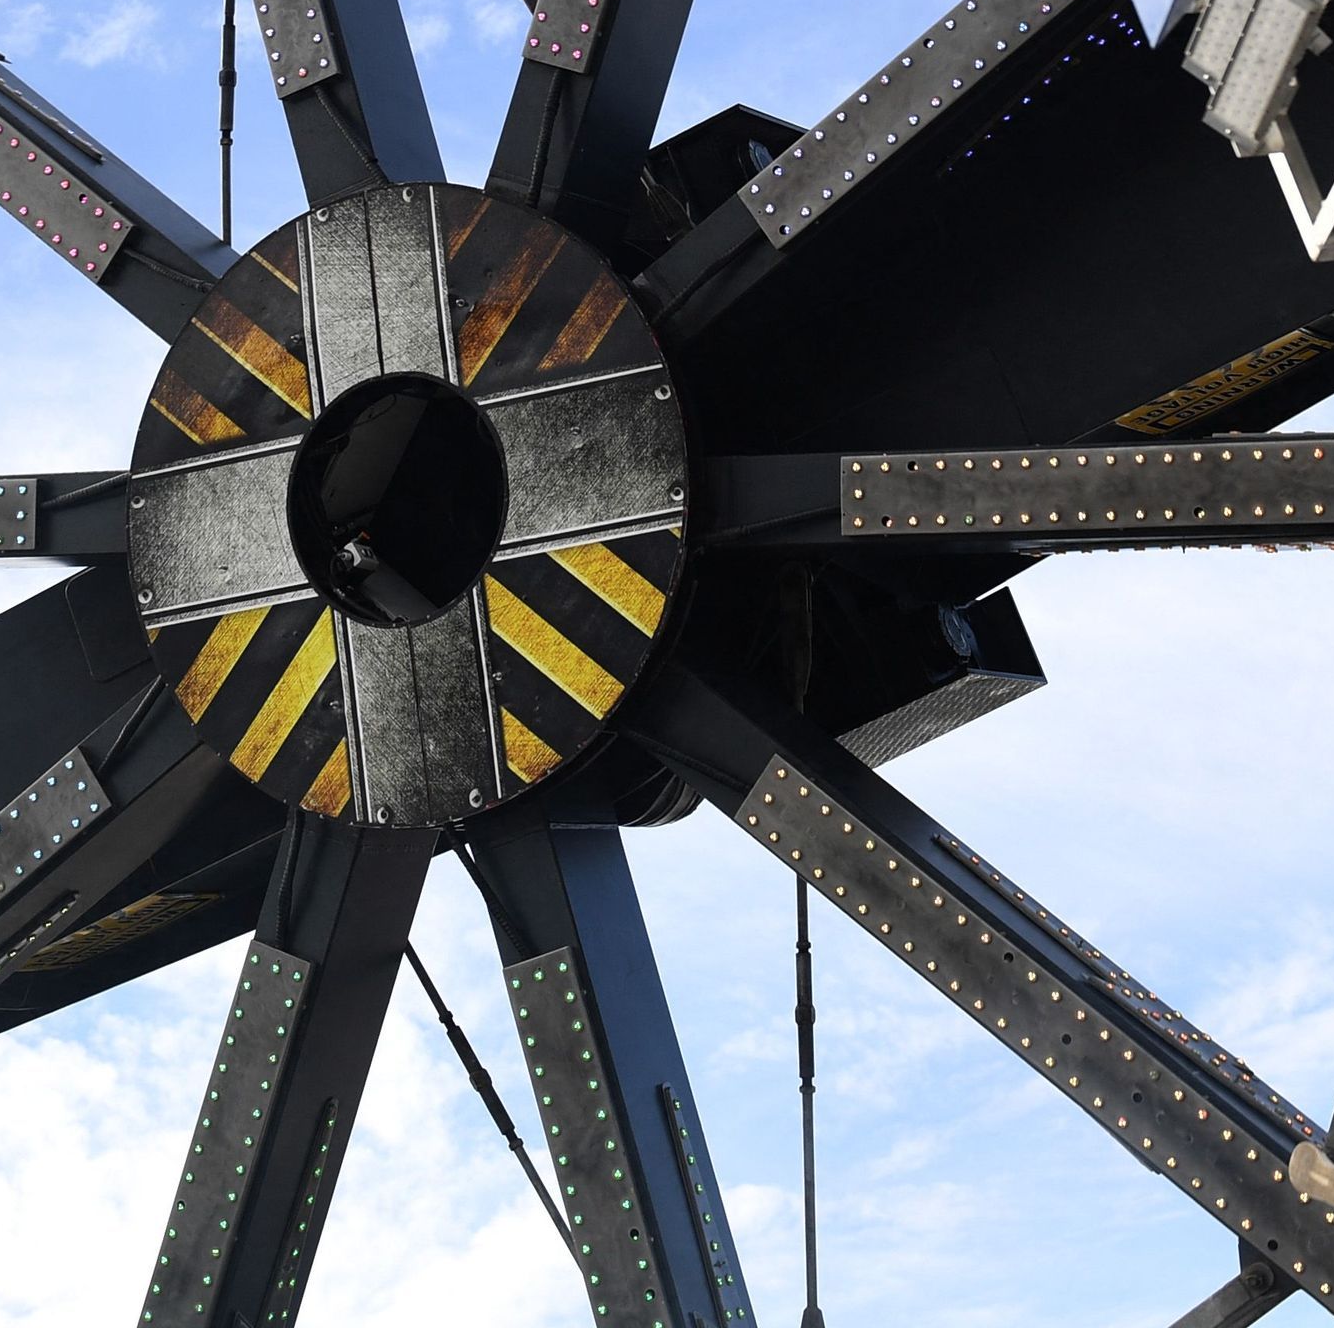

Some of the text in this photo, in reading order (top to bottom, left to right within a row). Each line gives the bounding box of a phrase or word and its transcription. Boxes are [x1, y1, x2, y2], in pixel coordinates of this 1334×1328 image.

[1131, 336, 1308, 425] HIGH VOLTAGE
[1175, 357, 1302, 419] WARNING
